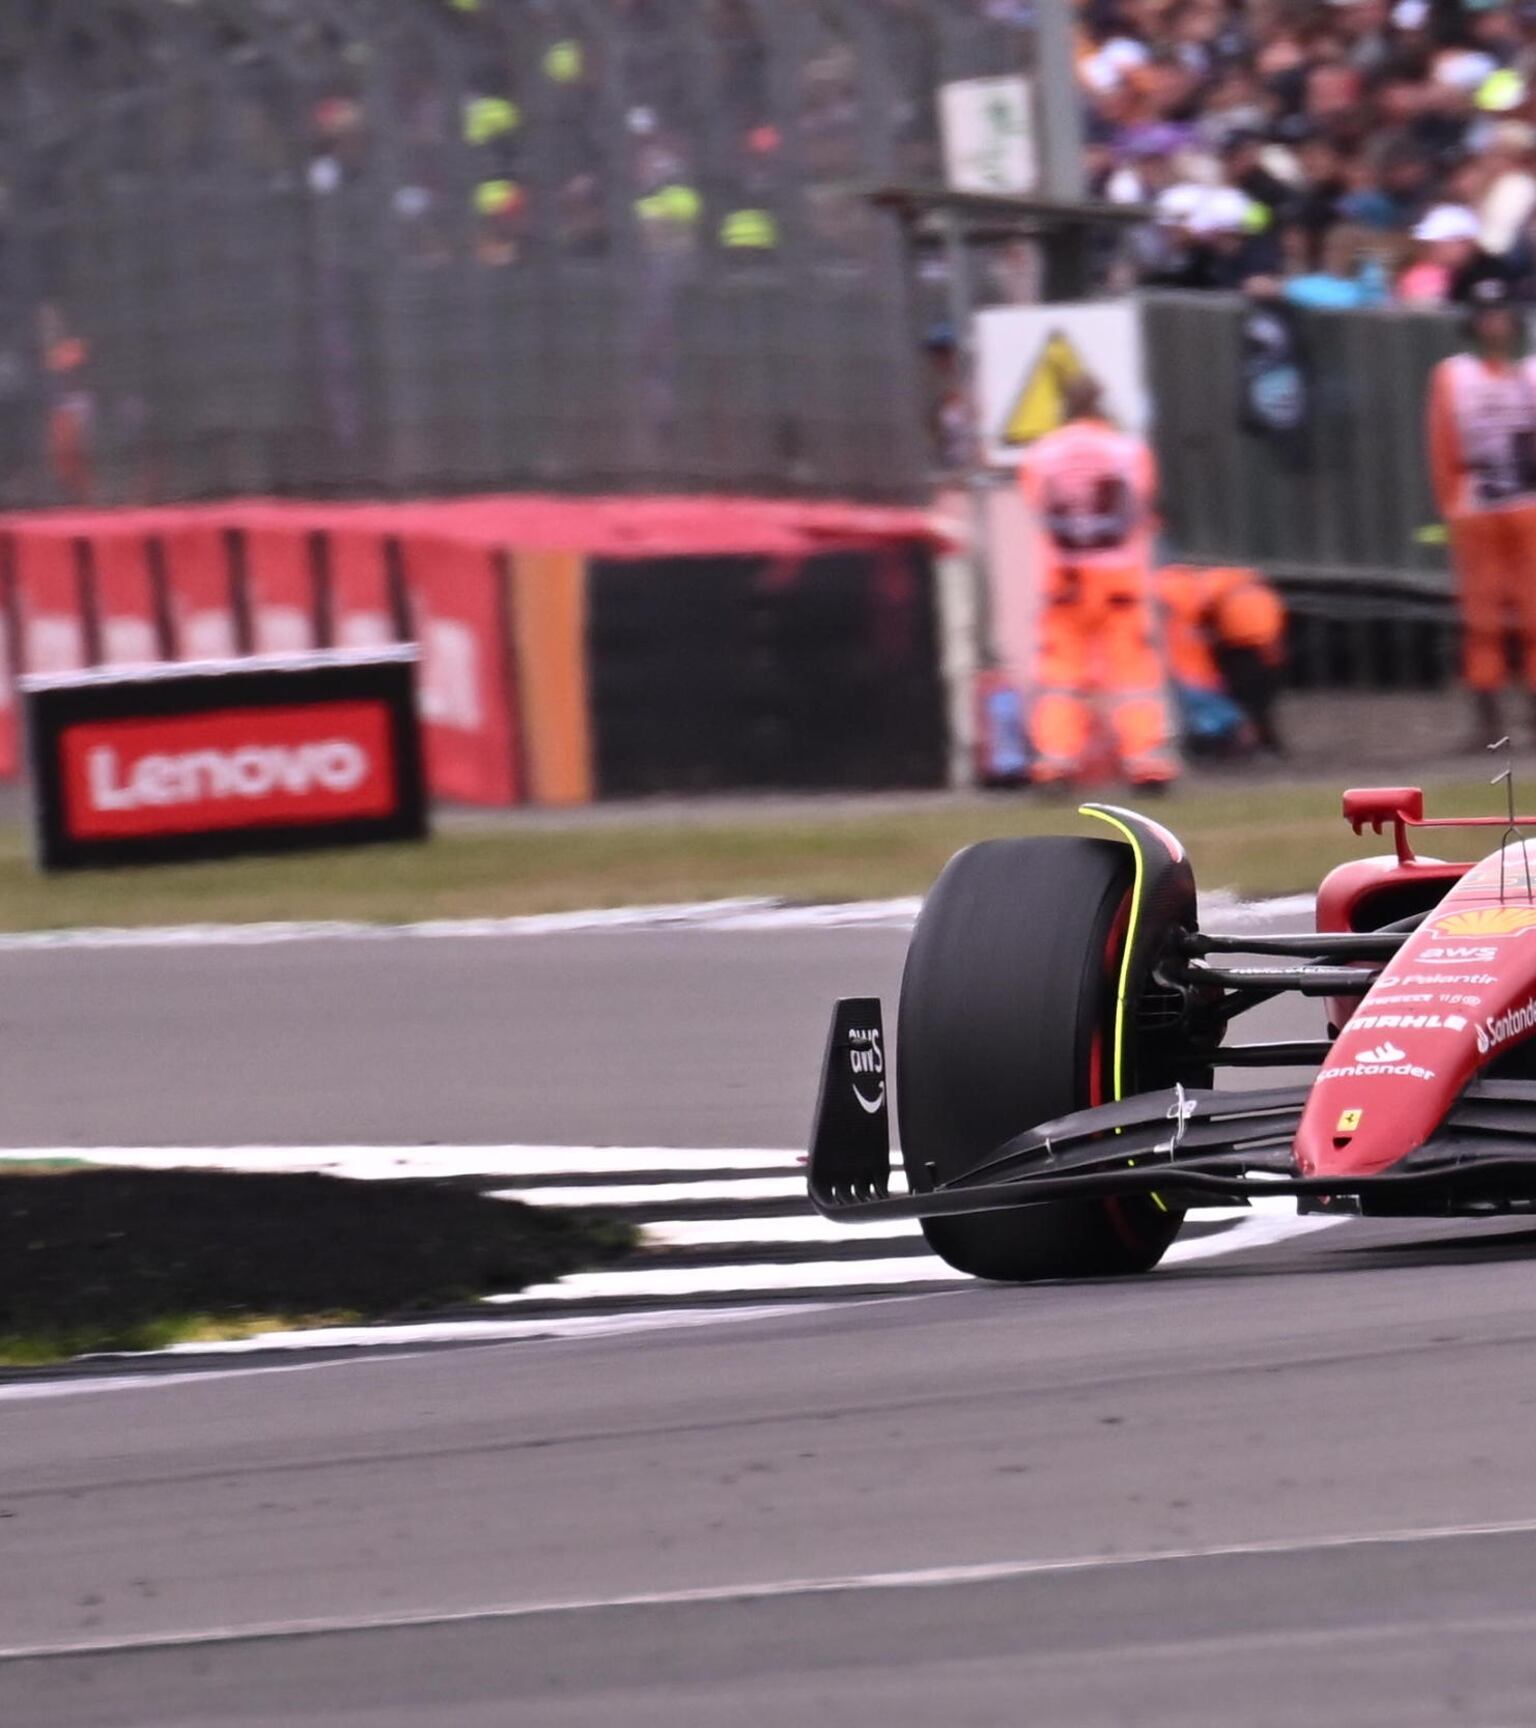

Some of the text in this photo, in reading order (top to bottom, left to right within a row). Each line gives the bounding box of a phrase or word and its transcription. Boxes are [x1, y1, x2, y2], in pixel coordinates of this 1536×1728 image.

[90, 739, 367, 811] Lenovo
[1417, 947, 1498, 959] aws
[1401, 974, 1498, 986] Palantir
[1344, 1014, 1468, 1033] MAHLE
